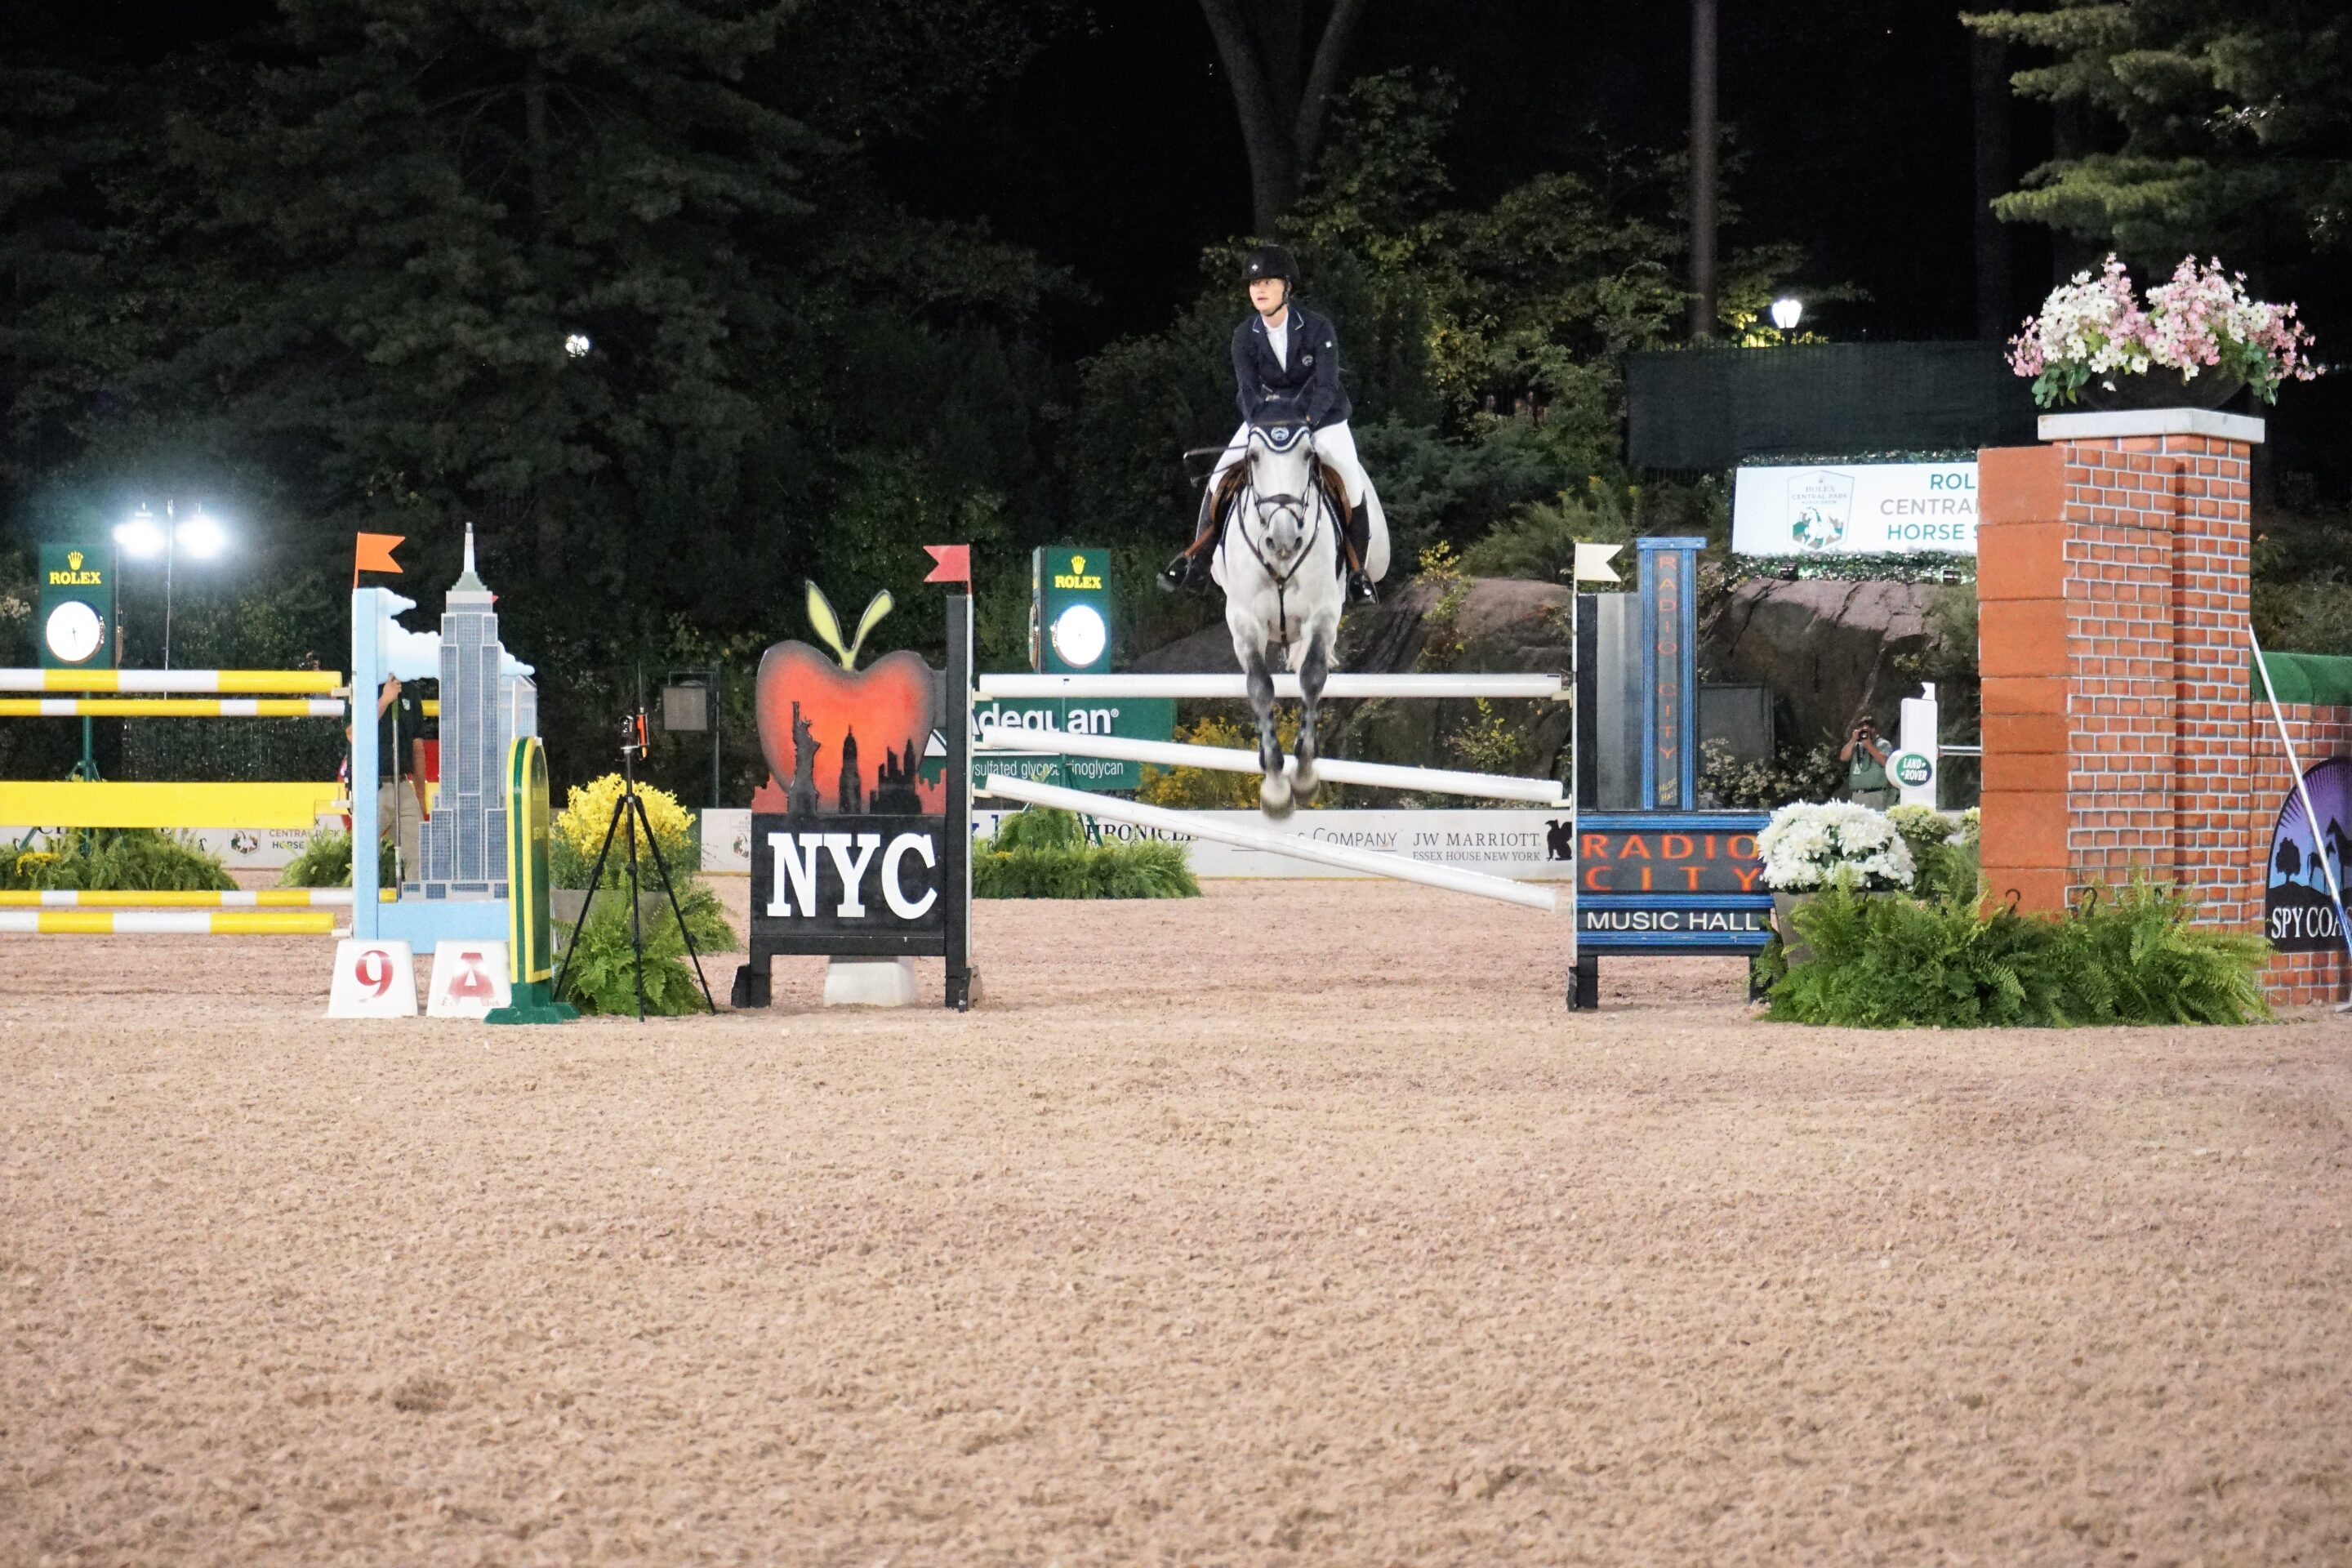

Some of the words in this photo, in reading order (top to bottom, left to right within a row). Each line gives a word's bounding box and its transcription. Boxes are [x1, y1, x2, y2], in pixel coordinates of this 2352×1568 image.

[1888, 523, 1965, 540] HORSE
[49, 572, 102, 585] ROLEX
[1054, 575, 1102, 590] ROLEX
[1658, 556, 1677, 654] RADIO
[1659, 684, 1677, 760] CITY
[1903, 757, 1922, 768] LAND
[1904, 769, 1927, 781] ROVER
[1413, 833, 1439, 846] JW
[1446, 833, 1539, 847] MARRIOTT
[1580, 834, 1759, 860] RADIO
[1413, 852, 1442, 861] ESSEX
[1446, 851, 1481, 861] HOUSE
[1484, 851, 1509, 861] NEW
[1512, 851, 1541, 861] YORK
[767, 832, 938, 920] NYC
[1584, 866, 1762, 892] CITY
[1588, 911, 1679, 930] MUSIC
[1689, 912, 1760, 931] HALL
[2271, 906, 2303, 939] SPY
[355, 950, 394, 1003] 9
[441, 952, 501, 1007] A
